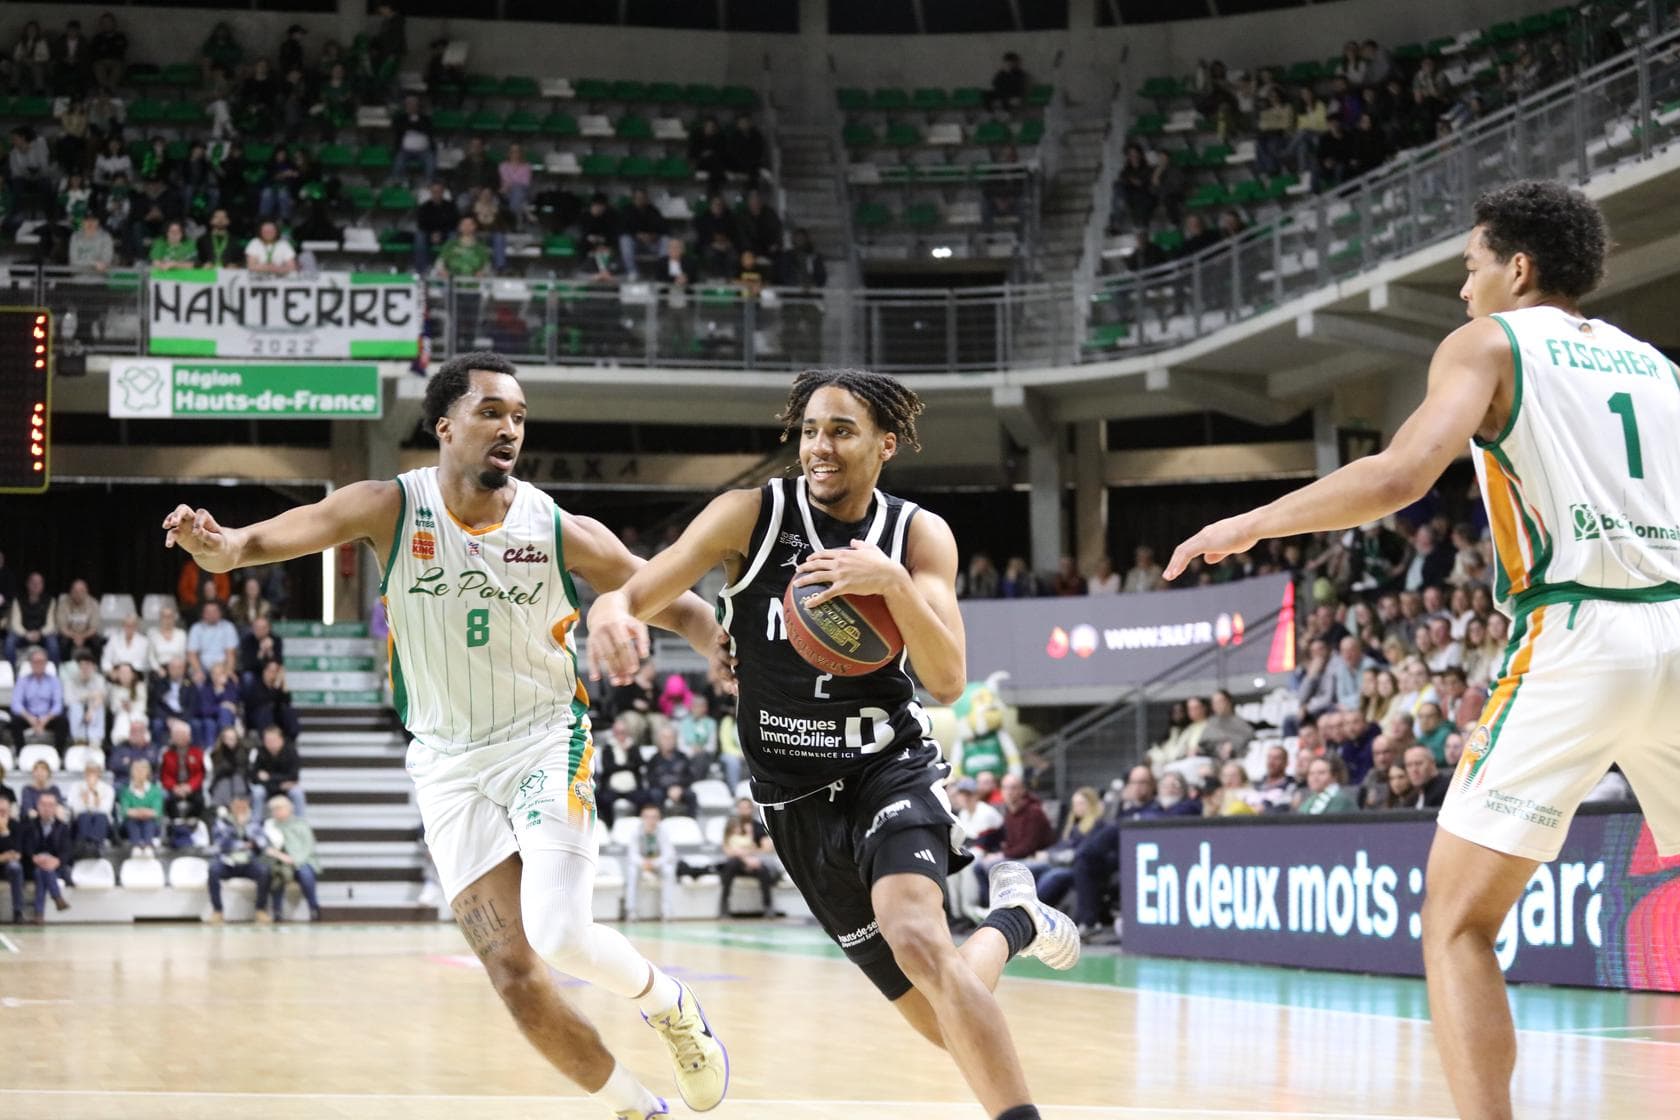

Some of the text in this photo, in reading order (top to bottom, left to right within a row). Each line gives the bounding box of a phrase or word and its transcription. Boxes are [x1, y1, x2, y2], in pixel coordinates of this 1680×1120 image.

[153, 282, 413, 328] NANTERRE
[252, 339, 319, 354] 2022
[1545, 339, 1661, 380] FISCHER
[174, 370, 242, 389] Région
[174, 392, 377, 412] Hauts-de-France
[1607, 392, 1644, 480] 1
[412, 545, 434, 555] KING
[503, 548, 549, 563] Chais
[408, 567, 544, 605] Le Portel
[466, 608, 490, 648] 8
[814, 673, 832, 699] 2
[760, 710, 837, 732] Bouygues
[760, 727, 842, 748] Immobilier
[762, 746, 771, 754] LA
[789, 749, 837, 758] COMMENCE
[1136, 843, 1180, 926] En
[1186, 841, 1280, 930] deux
[1288, 850, 1398, 938] mots
